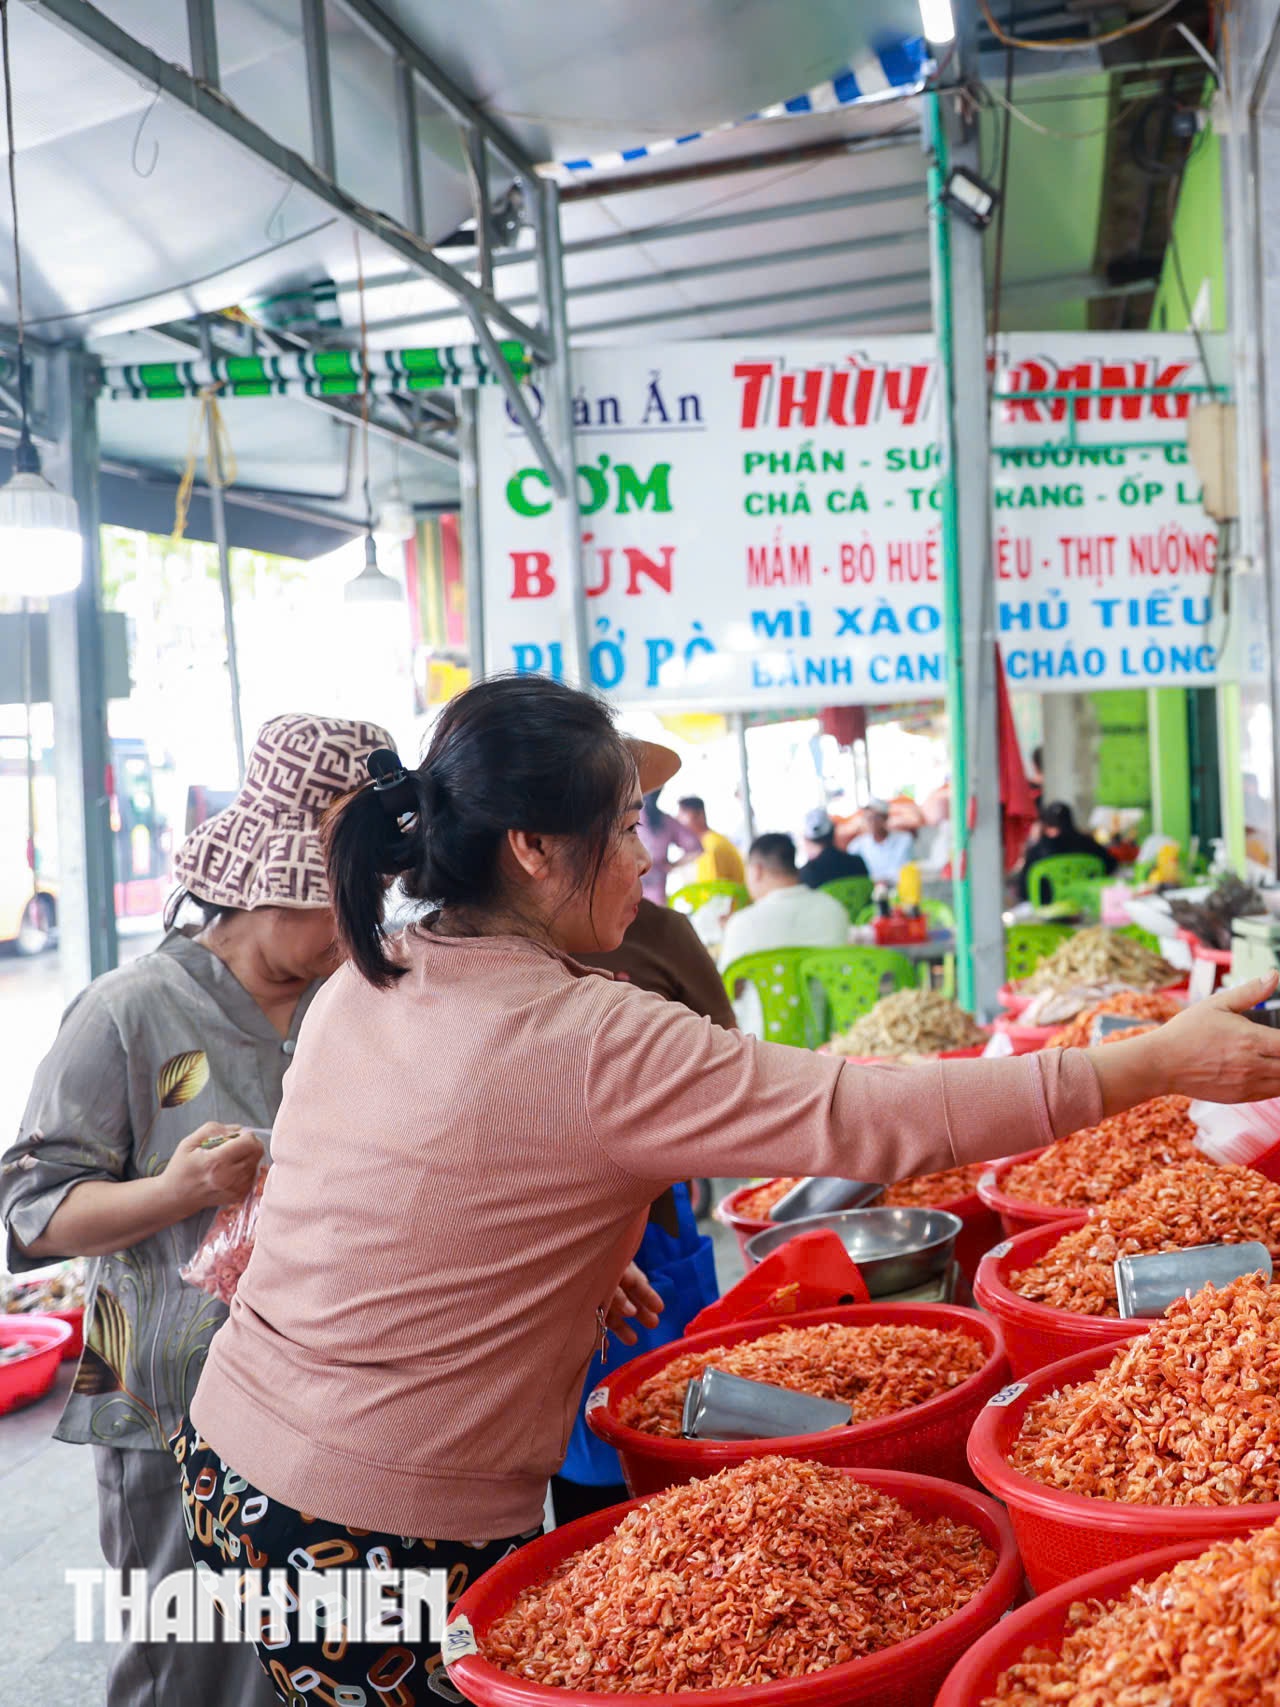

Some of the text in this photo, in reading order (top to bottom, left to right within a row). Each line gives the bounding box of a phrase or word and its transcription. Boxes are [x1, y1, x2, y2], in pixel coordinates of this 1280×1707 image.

[641, 367, 703, 424] Ăn
[985, 356, 1192, 424] RANG
[506, 453, 674, 517] CƠM
[508, 531, 677, 599] BÚN
[1058, 536, 1117, 588] THỊT
[836, 596, 941, 636] XÀO
[1091, 583, 1212, 628] TIẾU
[1006, 640, 1107, 679] CHÁO
[1121, 635, 1216, 676] LÒNG
